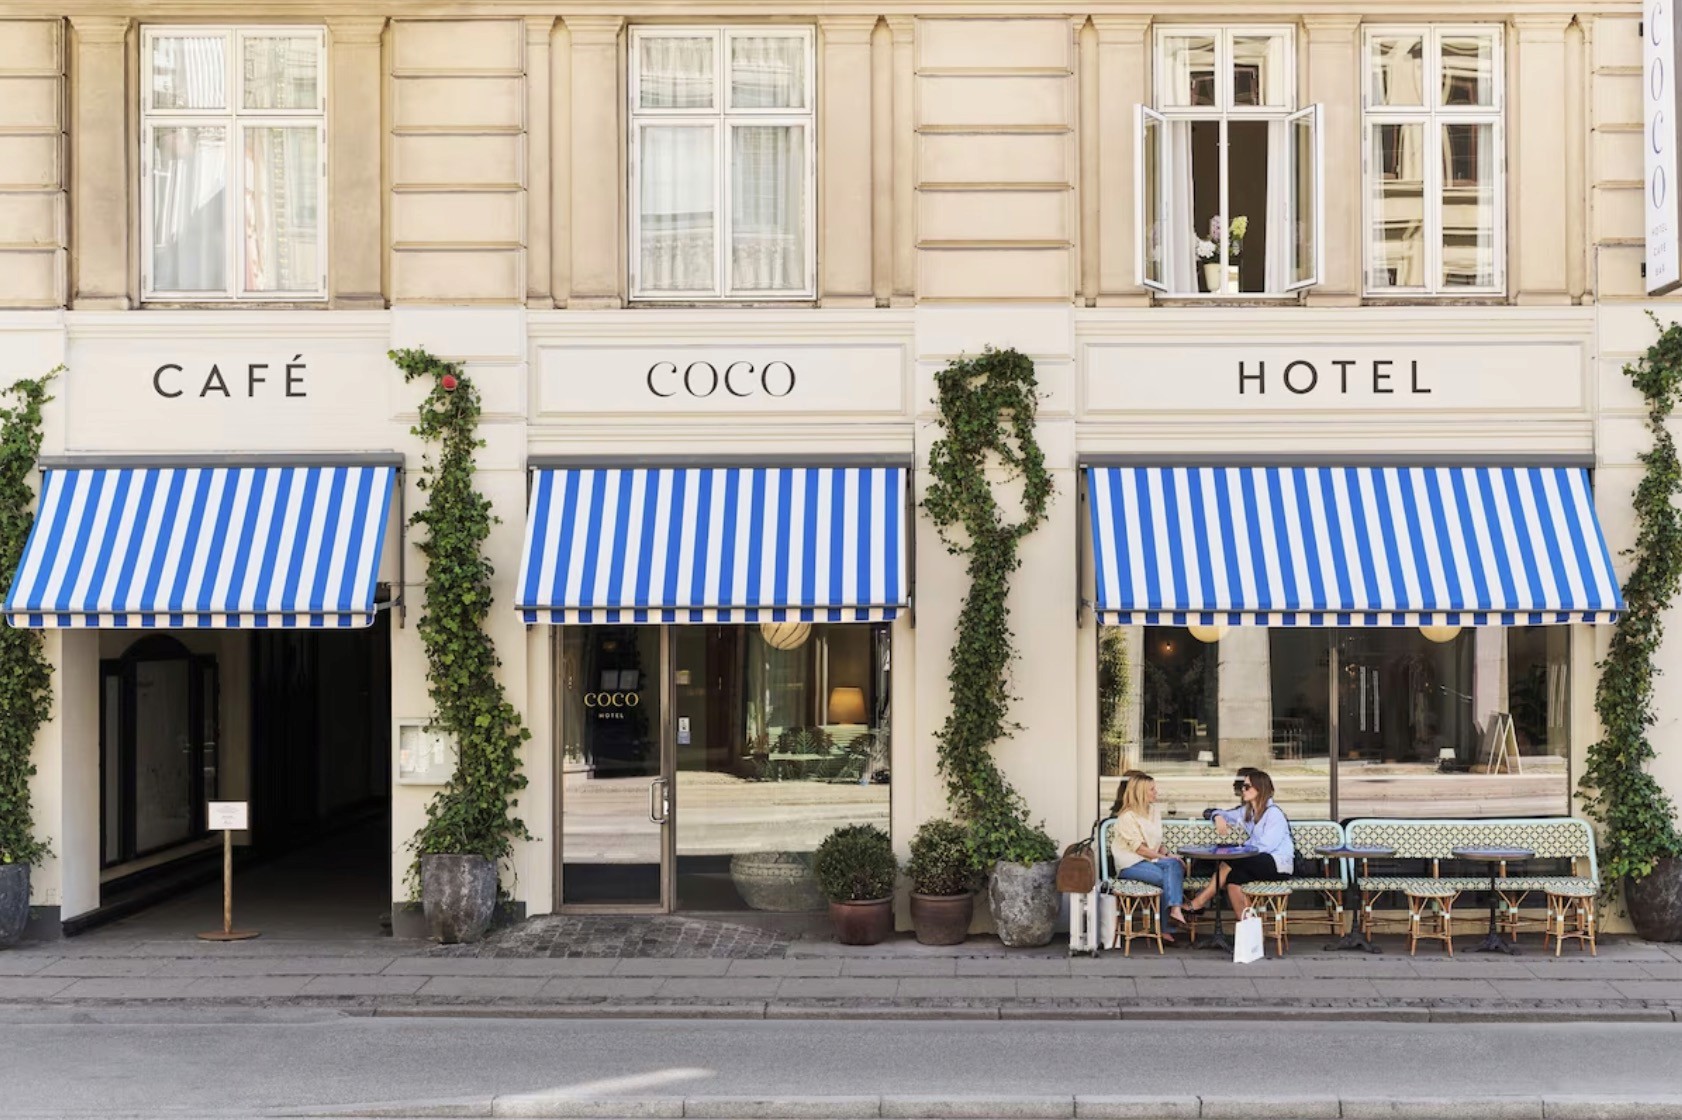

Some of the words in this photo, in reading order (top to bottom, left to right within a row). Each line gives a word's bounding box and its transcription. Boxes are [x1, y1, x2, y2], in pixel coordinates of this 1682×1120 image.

[1651, 2, 1666, 209] COCO
[153, 353, 307, 399] CAFÉ
[646, 361, 796, 398] COCO
[1239, 360, 1432, 395] HOTEL
[583, 692, 639, 707] COCO
